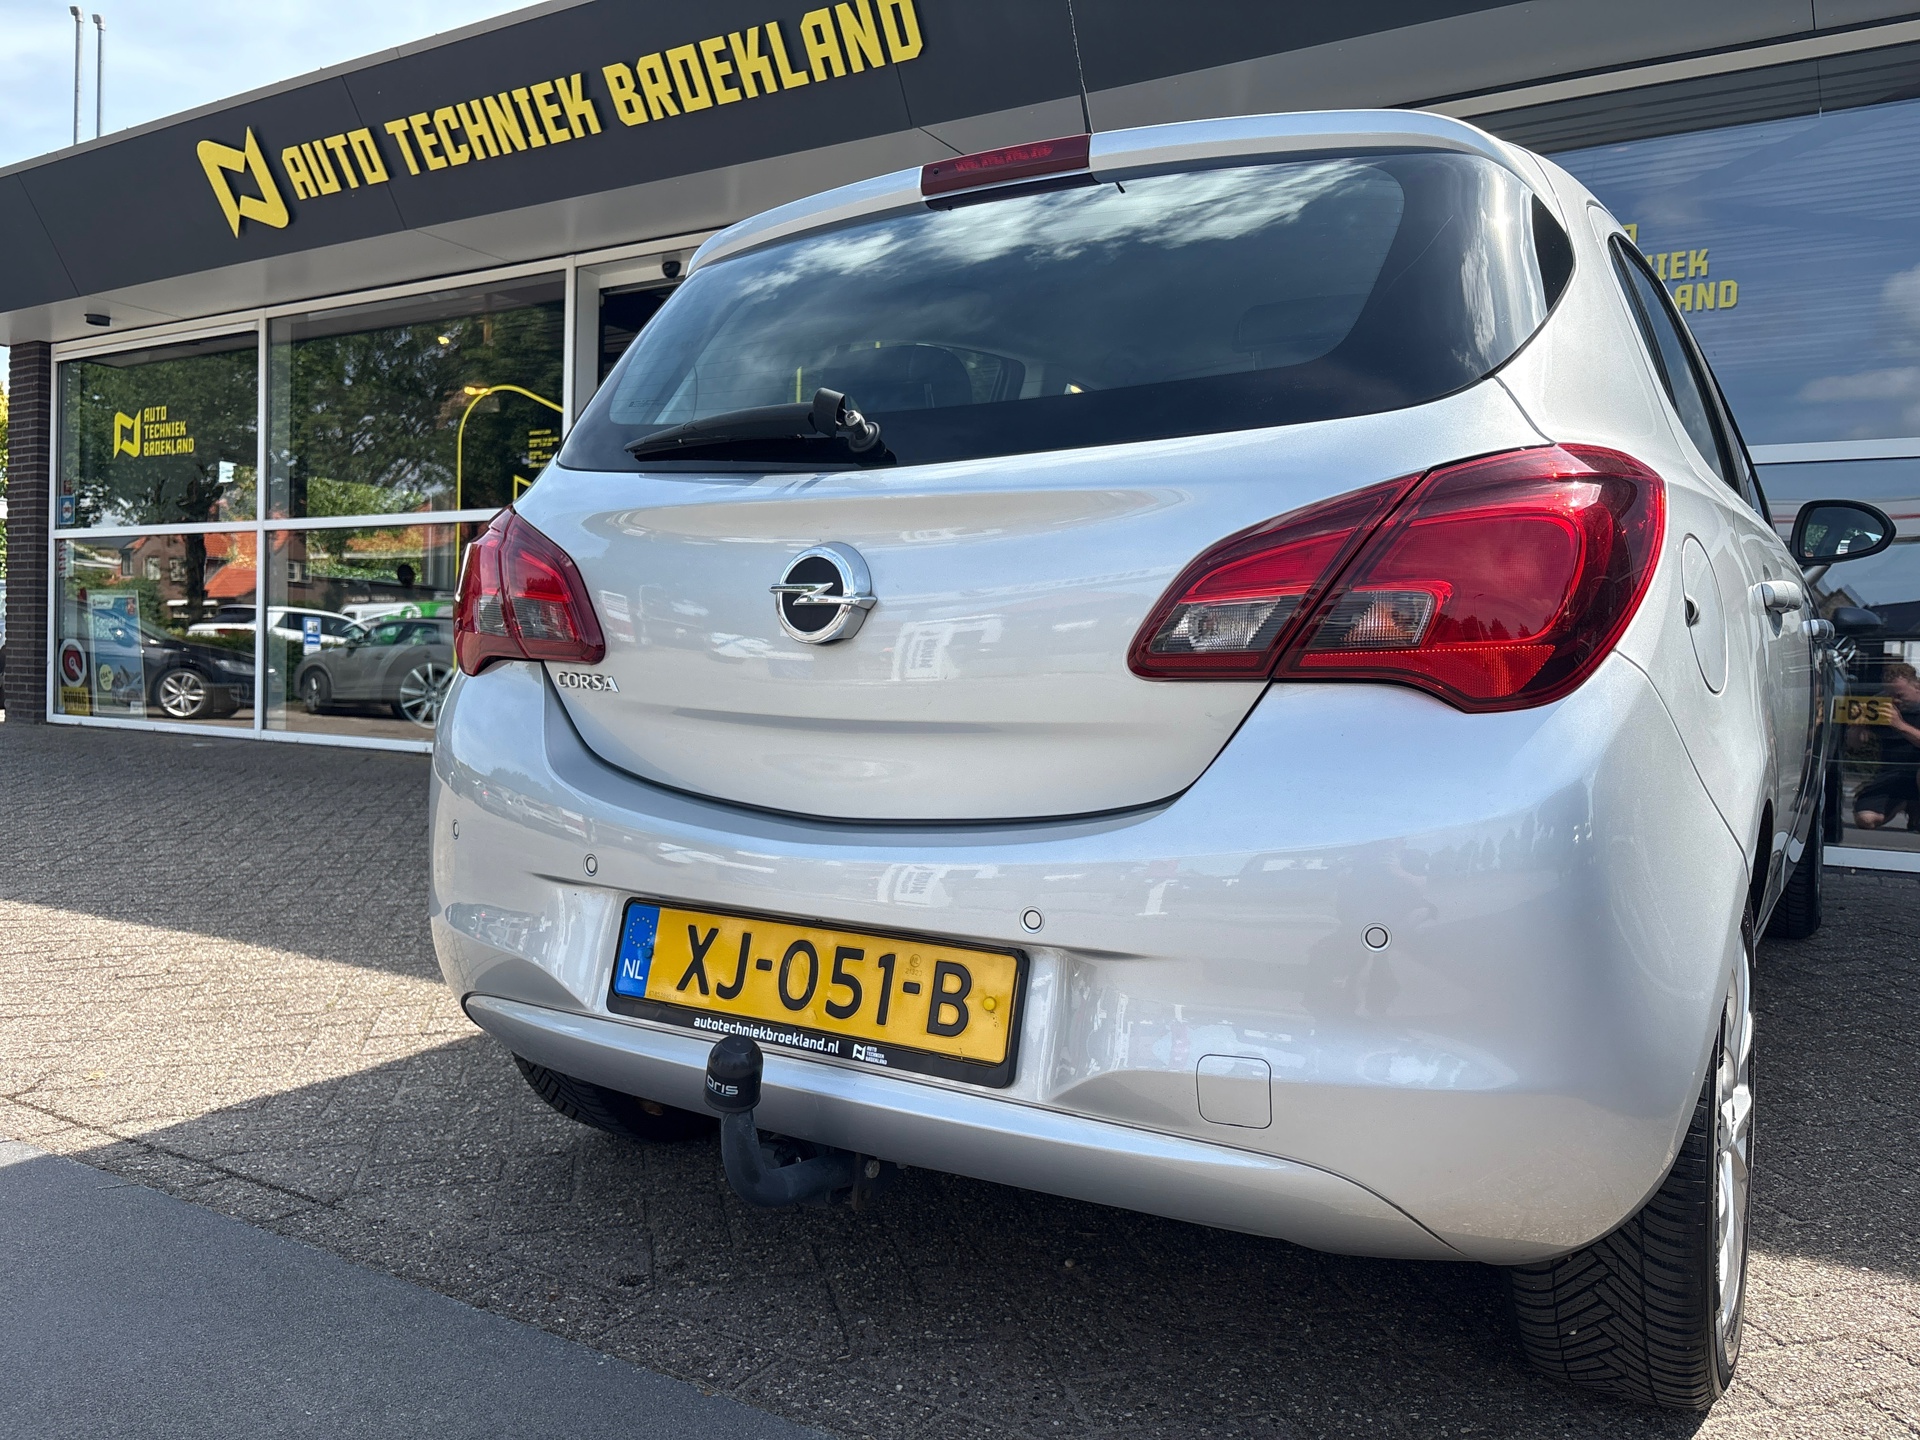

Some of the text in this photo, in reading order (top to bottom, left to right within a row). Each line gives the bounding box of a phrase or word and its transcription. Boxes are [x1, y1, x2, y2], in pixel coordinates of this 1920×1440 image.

[281, 0, 923, 200] AUTO TECHNIEK BROEKLAND
[144, 405, 167, 422] AUTO
[144, 421, 186, 439] TECHNIEK
[143, 438, 195, 457] BROEKLAND
[556, 671, 620, 693] CORSA
[622, 958, 644, 980] NL
[676, 924, 972, 1037] XJ-051-B
[693, 1017, 840, 1054] autotechniekbroekland.nl
